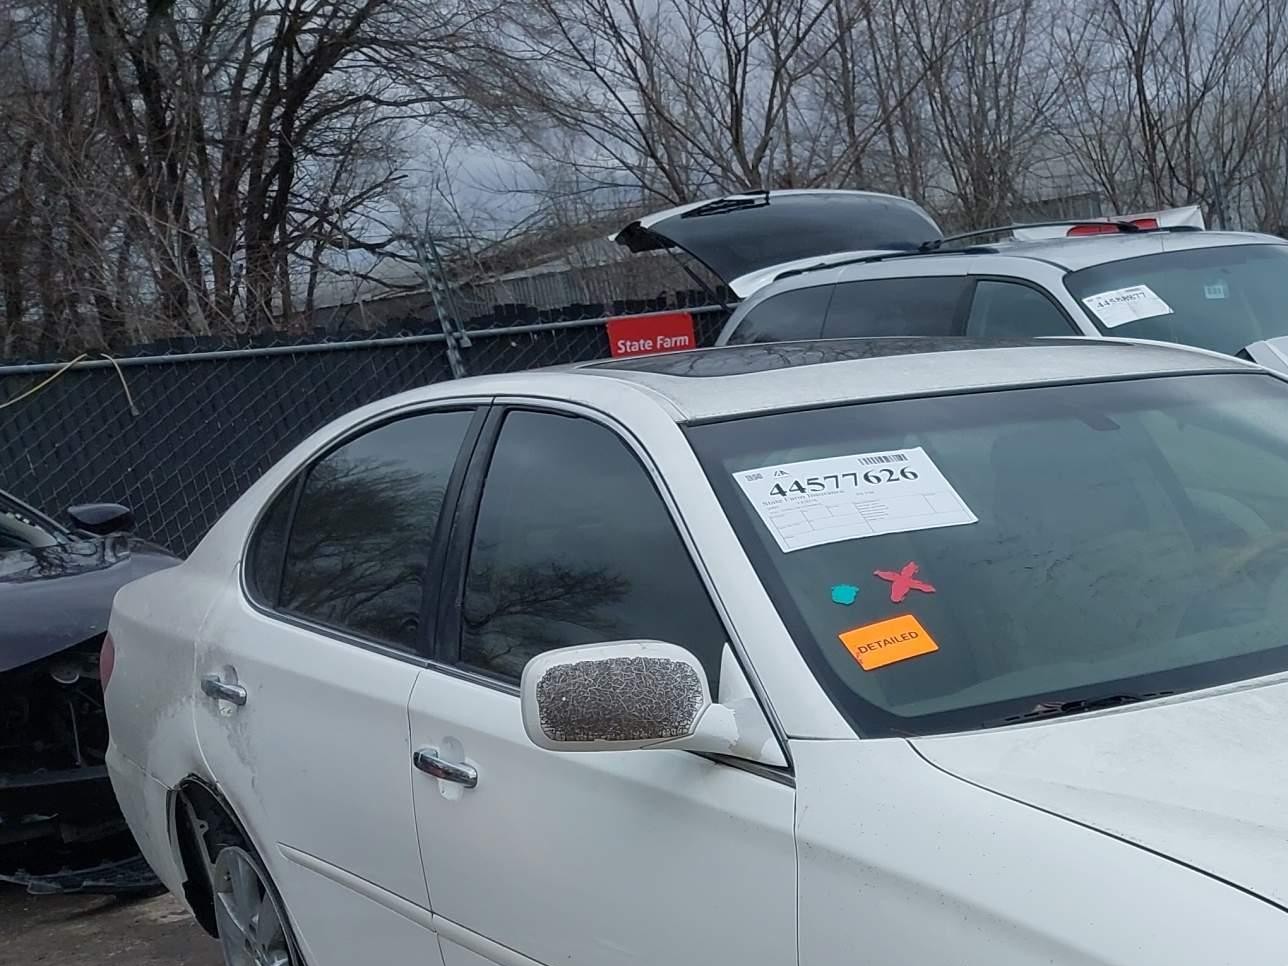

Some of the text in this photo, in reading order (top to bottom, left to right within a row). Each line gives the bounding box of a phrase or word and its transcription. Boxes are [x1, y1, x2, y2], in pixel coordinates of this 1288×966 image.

[617, 336, 689, 353] State Farm
[769, 466, 919, 497] 44577626
[858, 631, 919, 654] DETAILED
